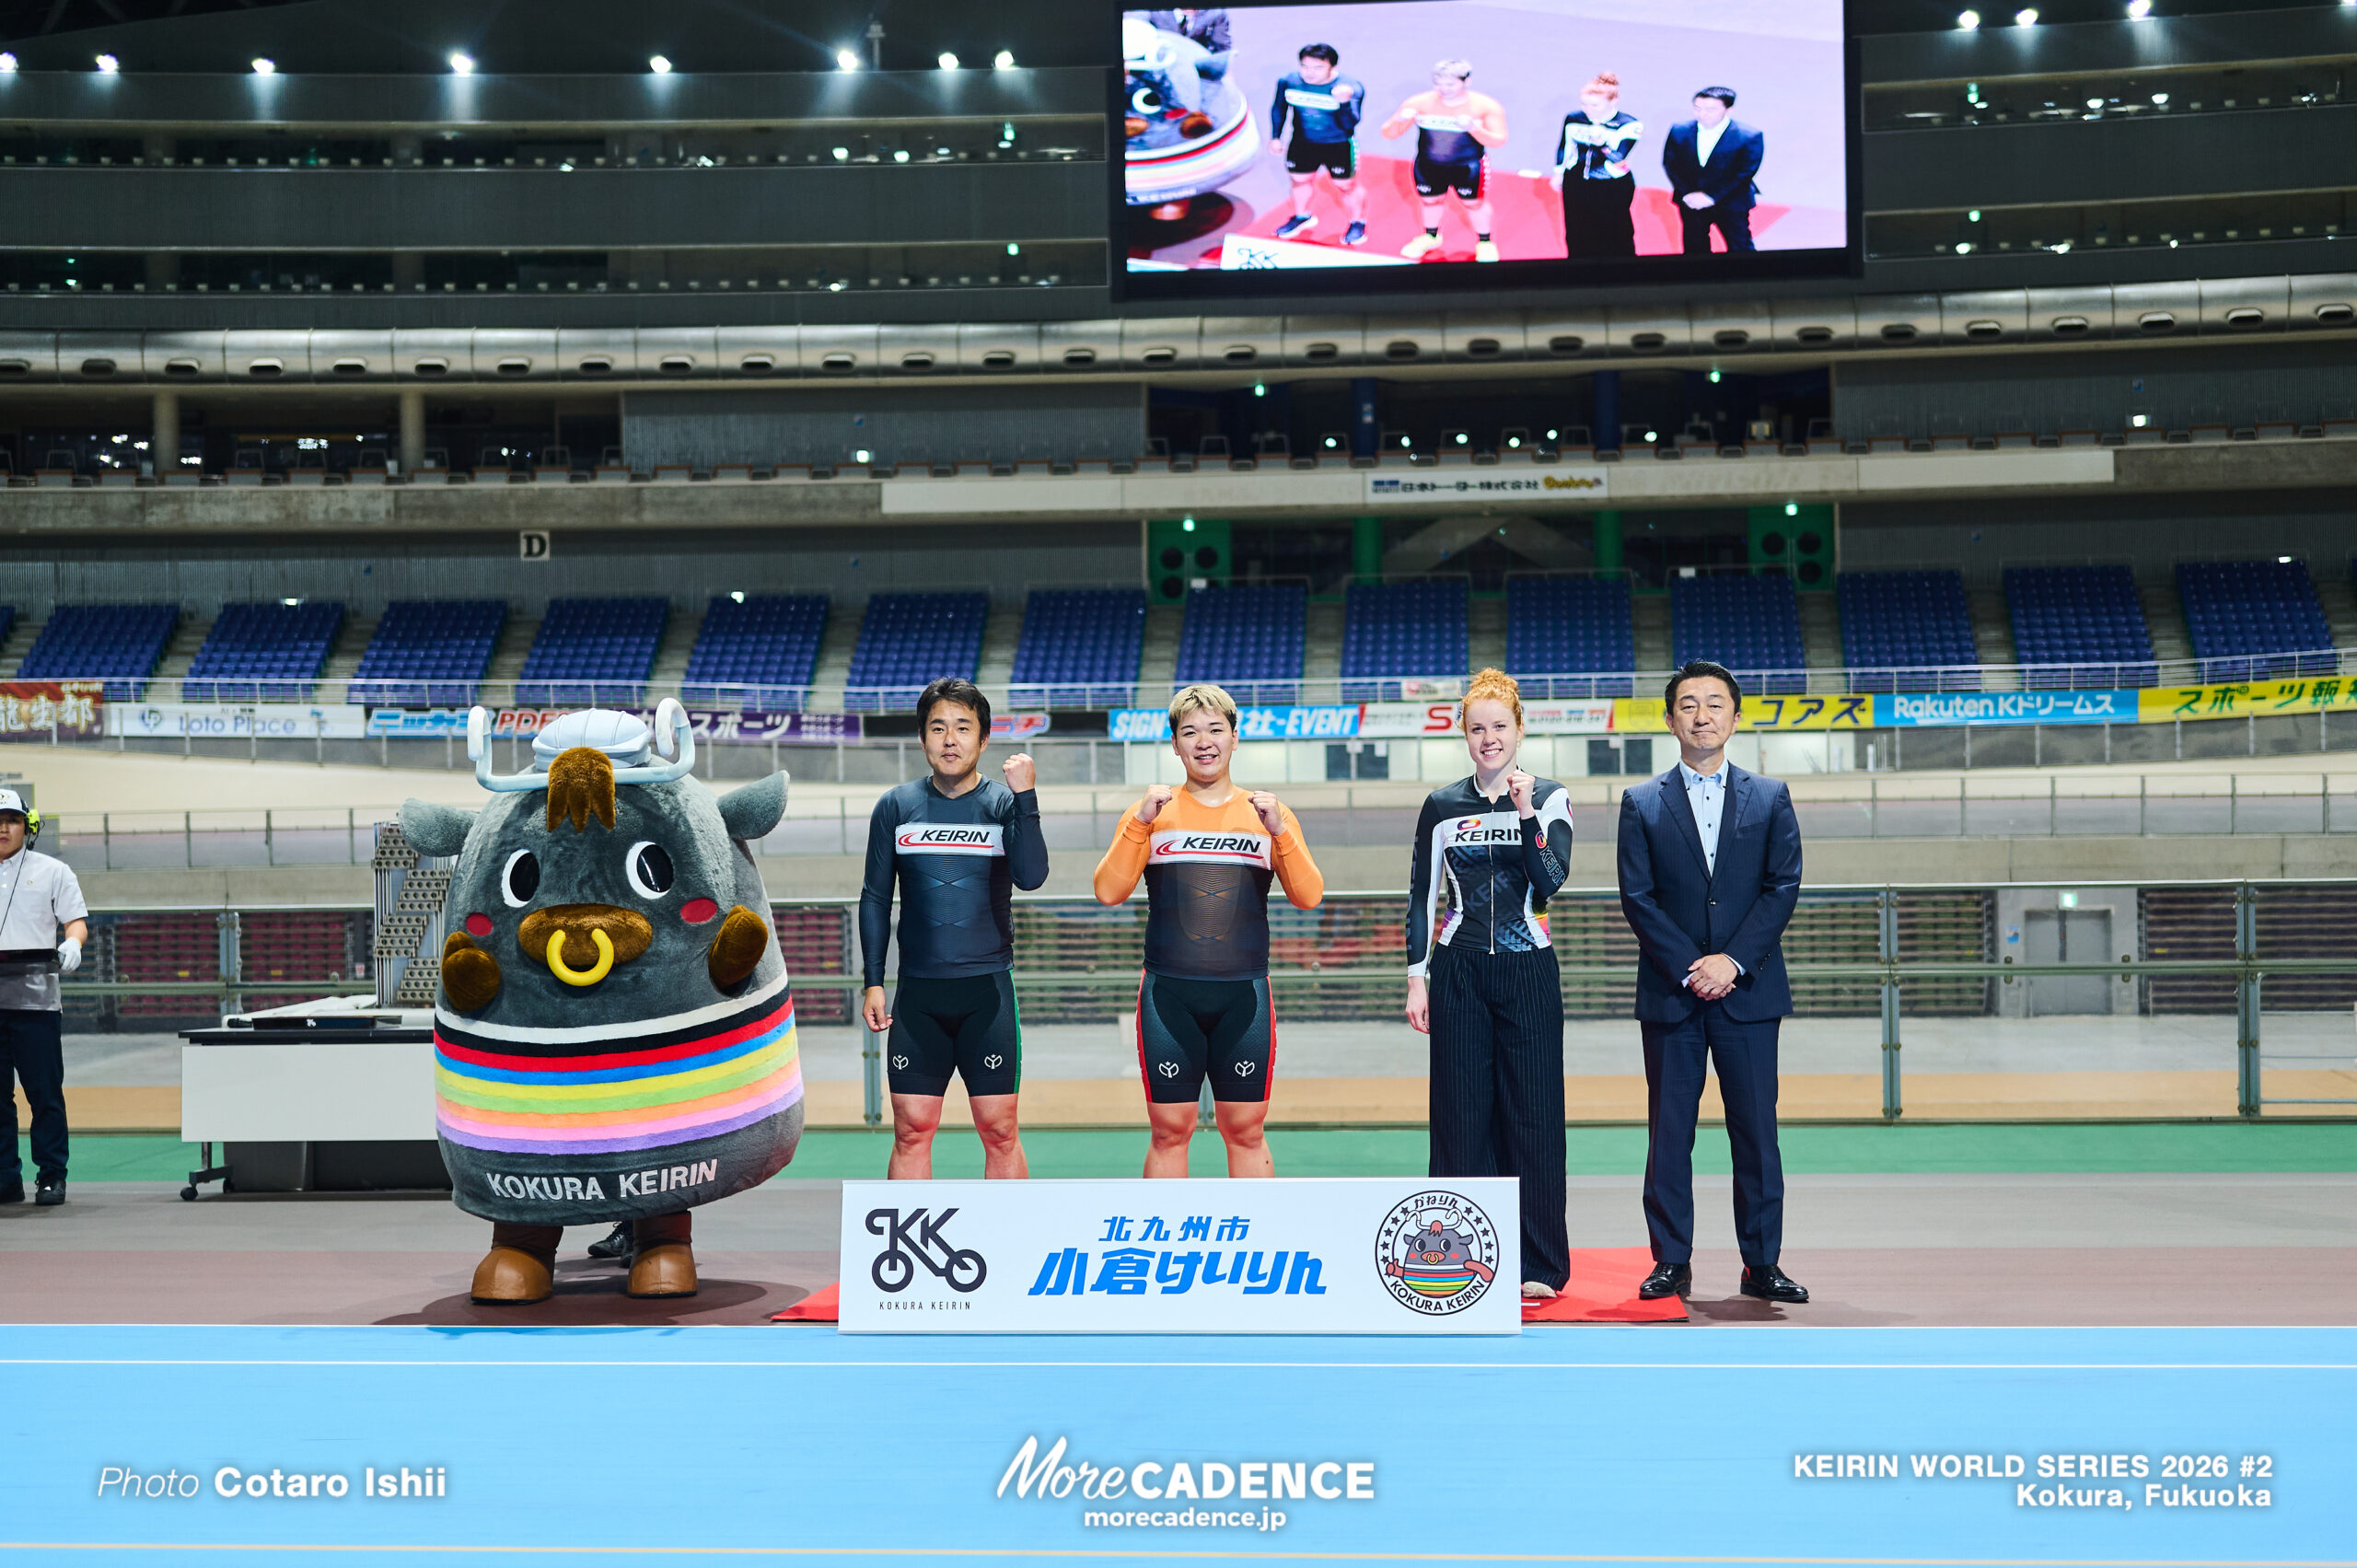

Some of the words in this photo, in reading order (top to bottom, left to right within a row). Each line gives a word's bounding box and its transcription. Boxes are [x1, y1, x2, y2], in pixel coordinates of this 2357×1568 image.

[523, 534, 547, 558] D
[1894, 695, 1994, 717] Rakuten
[1998, 694, 2116, 716] Kドリームス
[179, 714, 226, 734] Loto
[233, 714, 296, 734] Place
[497, 709, 566, 735] PDF
[921, 830, 991, 843] KEIRIN
[1182, 837, 1261, 854] KEIRIN
[486, 1172, 606, 1201] KOKURA
[619, 1158, 718, 1198] KEIRIN
[1098, 1216, 1250, 1241] 北九州市
[1028, 1248, 1328, 1295] 小倉けいりん
[879, 1301, 923, 1310] KOKURA
[932, 1301, 971, 1310] KEIRIN
[1390, 1280, 1444, 1311] KOKURA
[1446, 1280, 1485, 1310] KEIRIN
